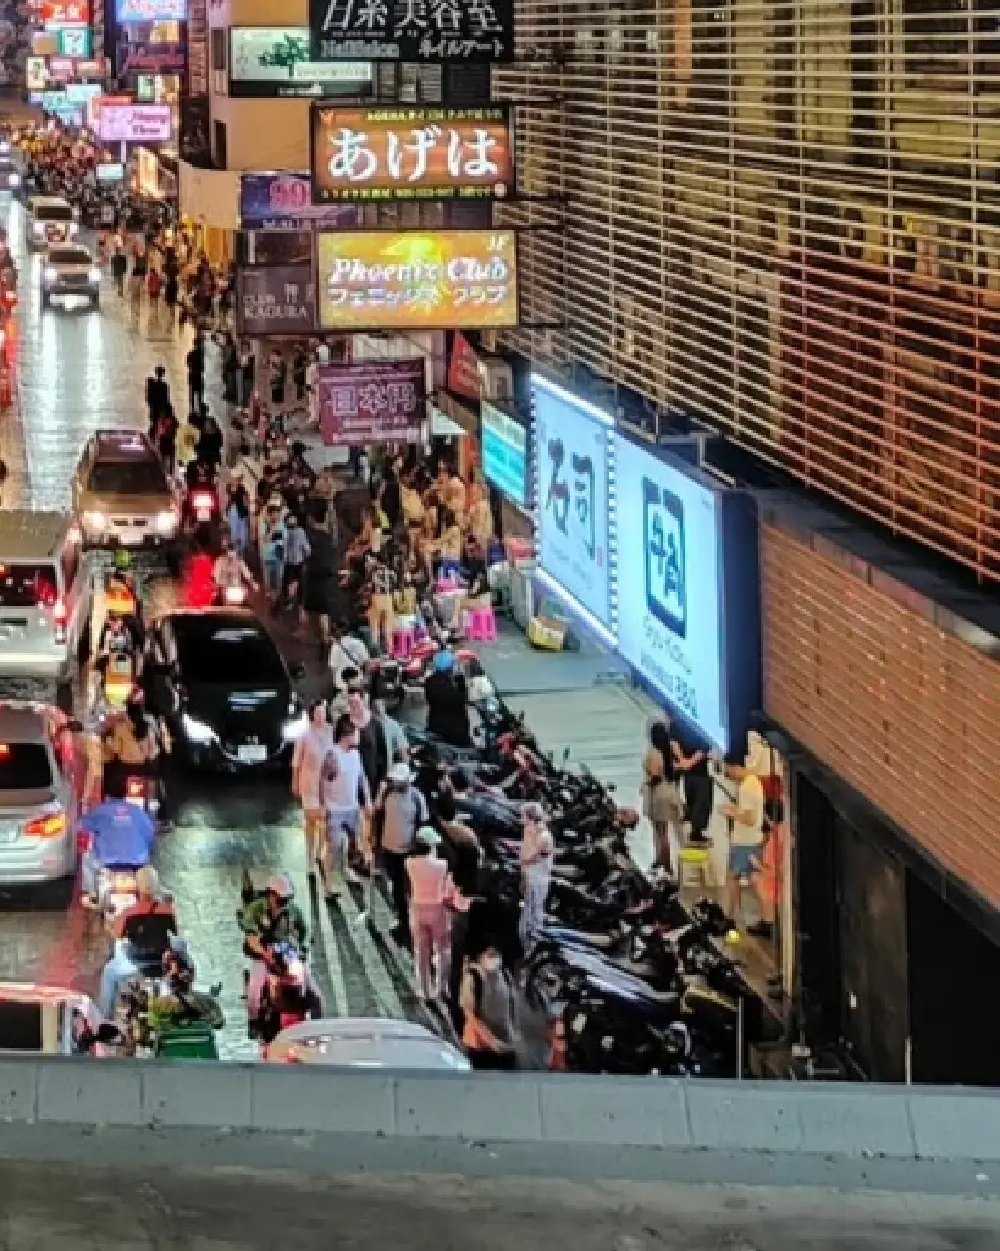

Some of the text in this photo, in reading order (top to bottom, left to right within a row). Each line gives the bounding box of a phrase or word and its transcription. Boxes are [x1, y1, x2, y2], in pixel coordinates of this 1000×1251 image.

[328, 124, 498, 181] あげは
[447, 257, 509, 281] Club
